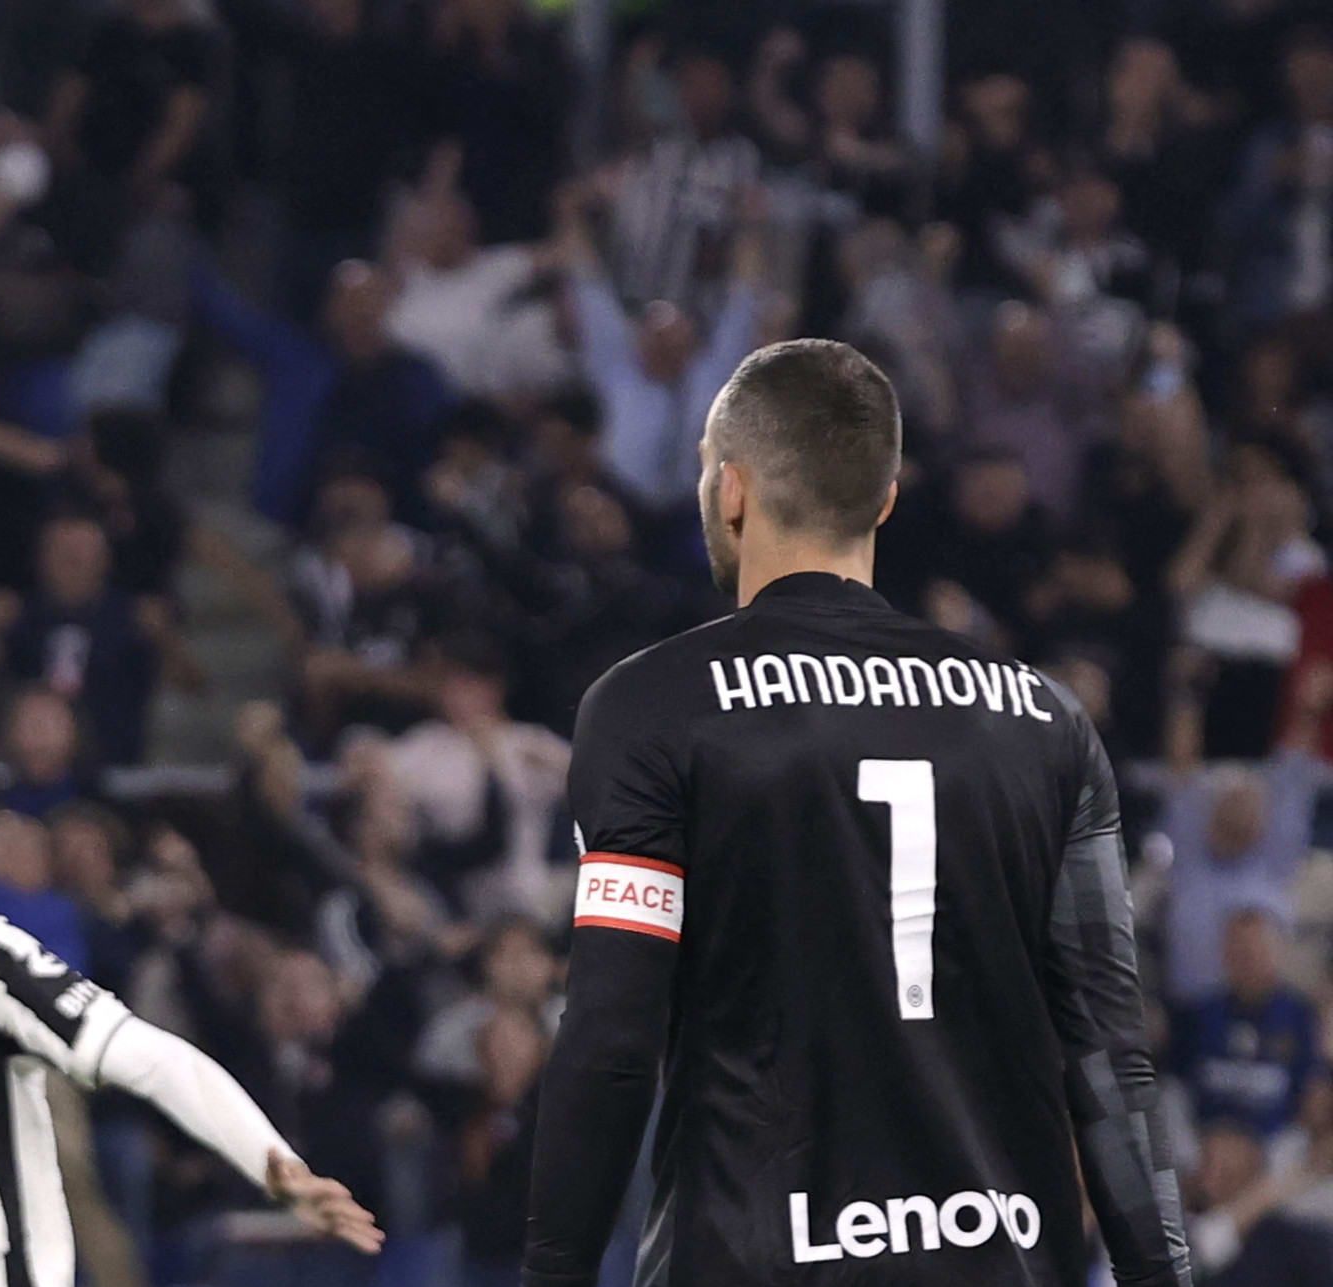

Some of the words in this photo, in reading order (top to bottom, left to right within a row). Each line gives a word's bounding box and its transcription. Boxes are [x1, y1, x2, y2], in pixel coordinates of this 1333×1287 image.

[586, 878, 675, 913] PEACE
[858, 759, 936, 1019] 1
[789, 1189, 1041, 1263] Lenovo
